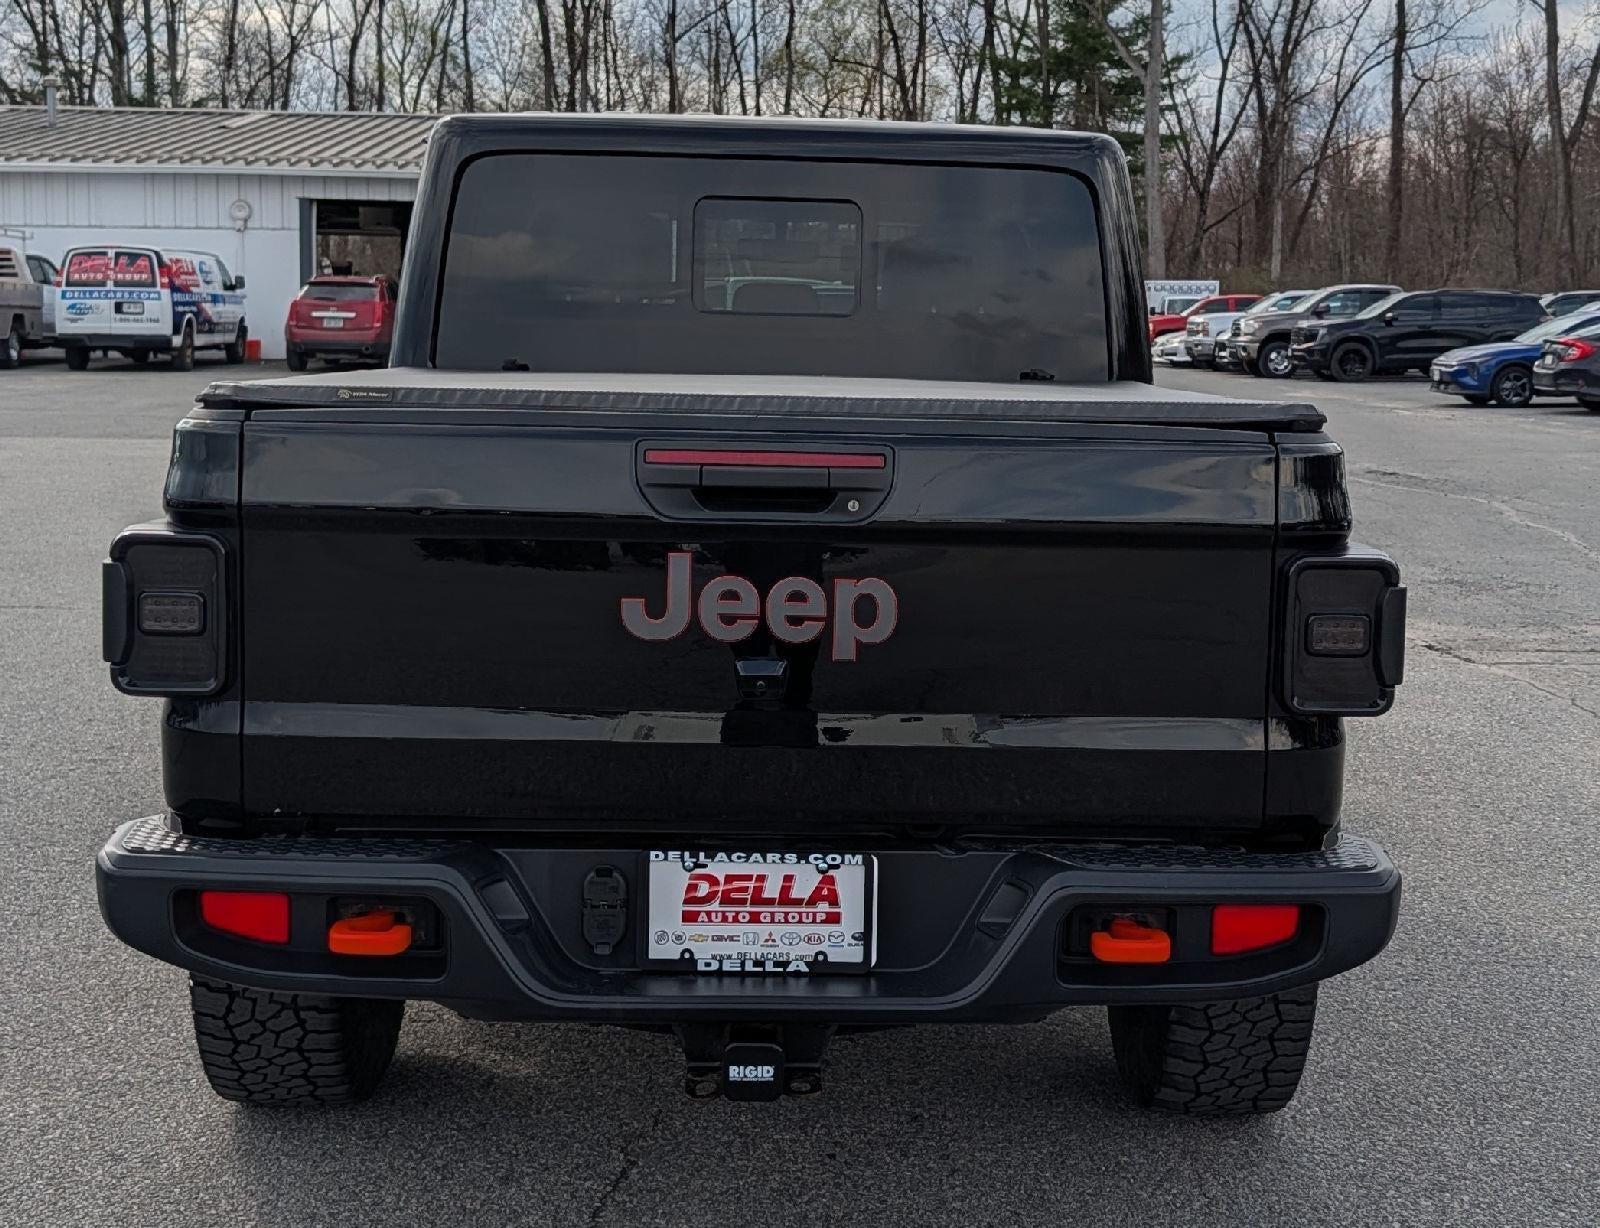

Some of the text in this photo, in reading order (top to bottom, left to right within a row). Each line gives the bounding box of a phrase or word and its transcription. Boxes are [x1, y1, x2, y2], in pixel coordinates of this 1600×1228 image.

[69, 255, 151, 274] DELLA
[74, 270, 149, 281] AUTO GROUP
[65, 291, 159, 299] DELLACARS.COM
[620, 552, 898, 661] Jeep
[649, 850, 863, 865] DELLACARS.COM
[682, 873, 841, 908] DELLA
[697, 911, 827, 923] AUTO GROUP
[697, 959, 810, 972] DELLA
[729, 1065, 775, 1078] RIGID
